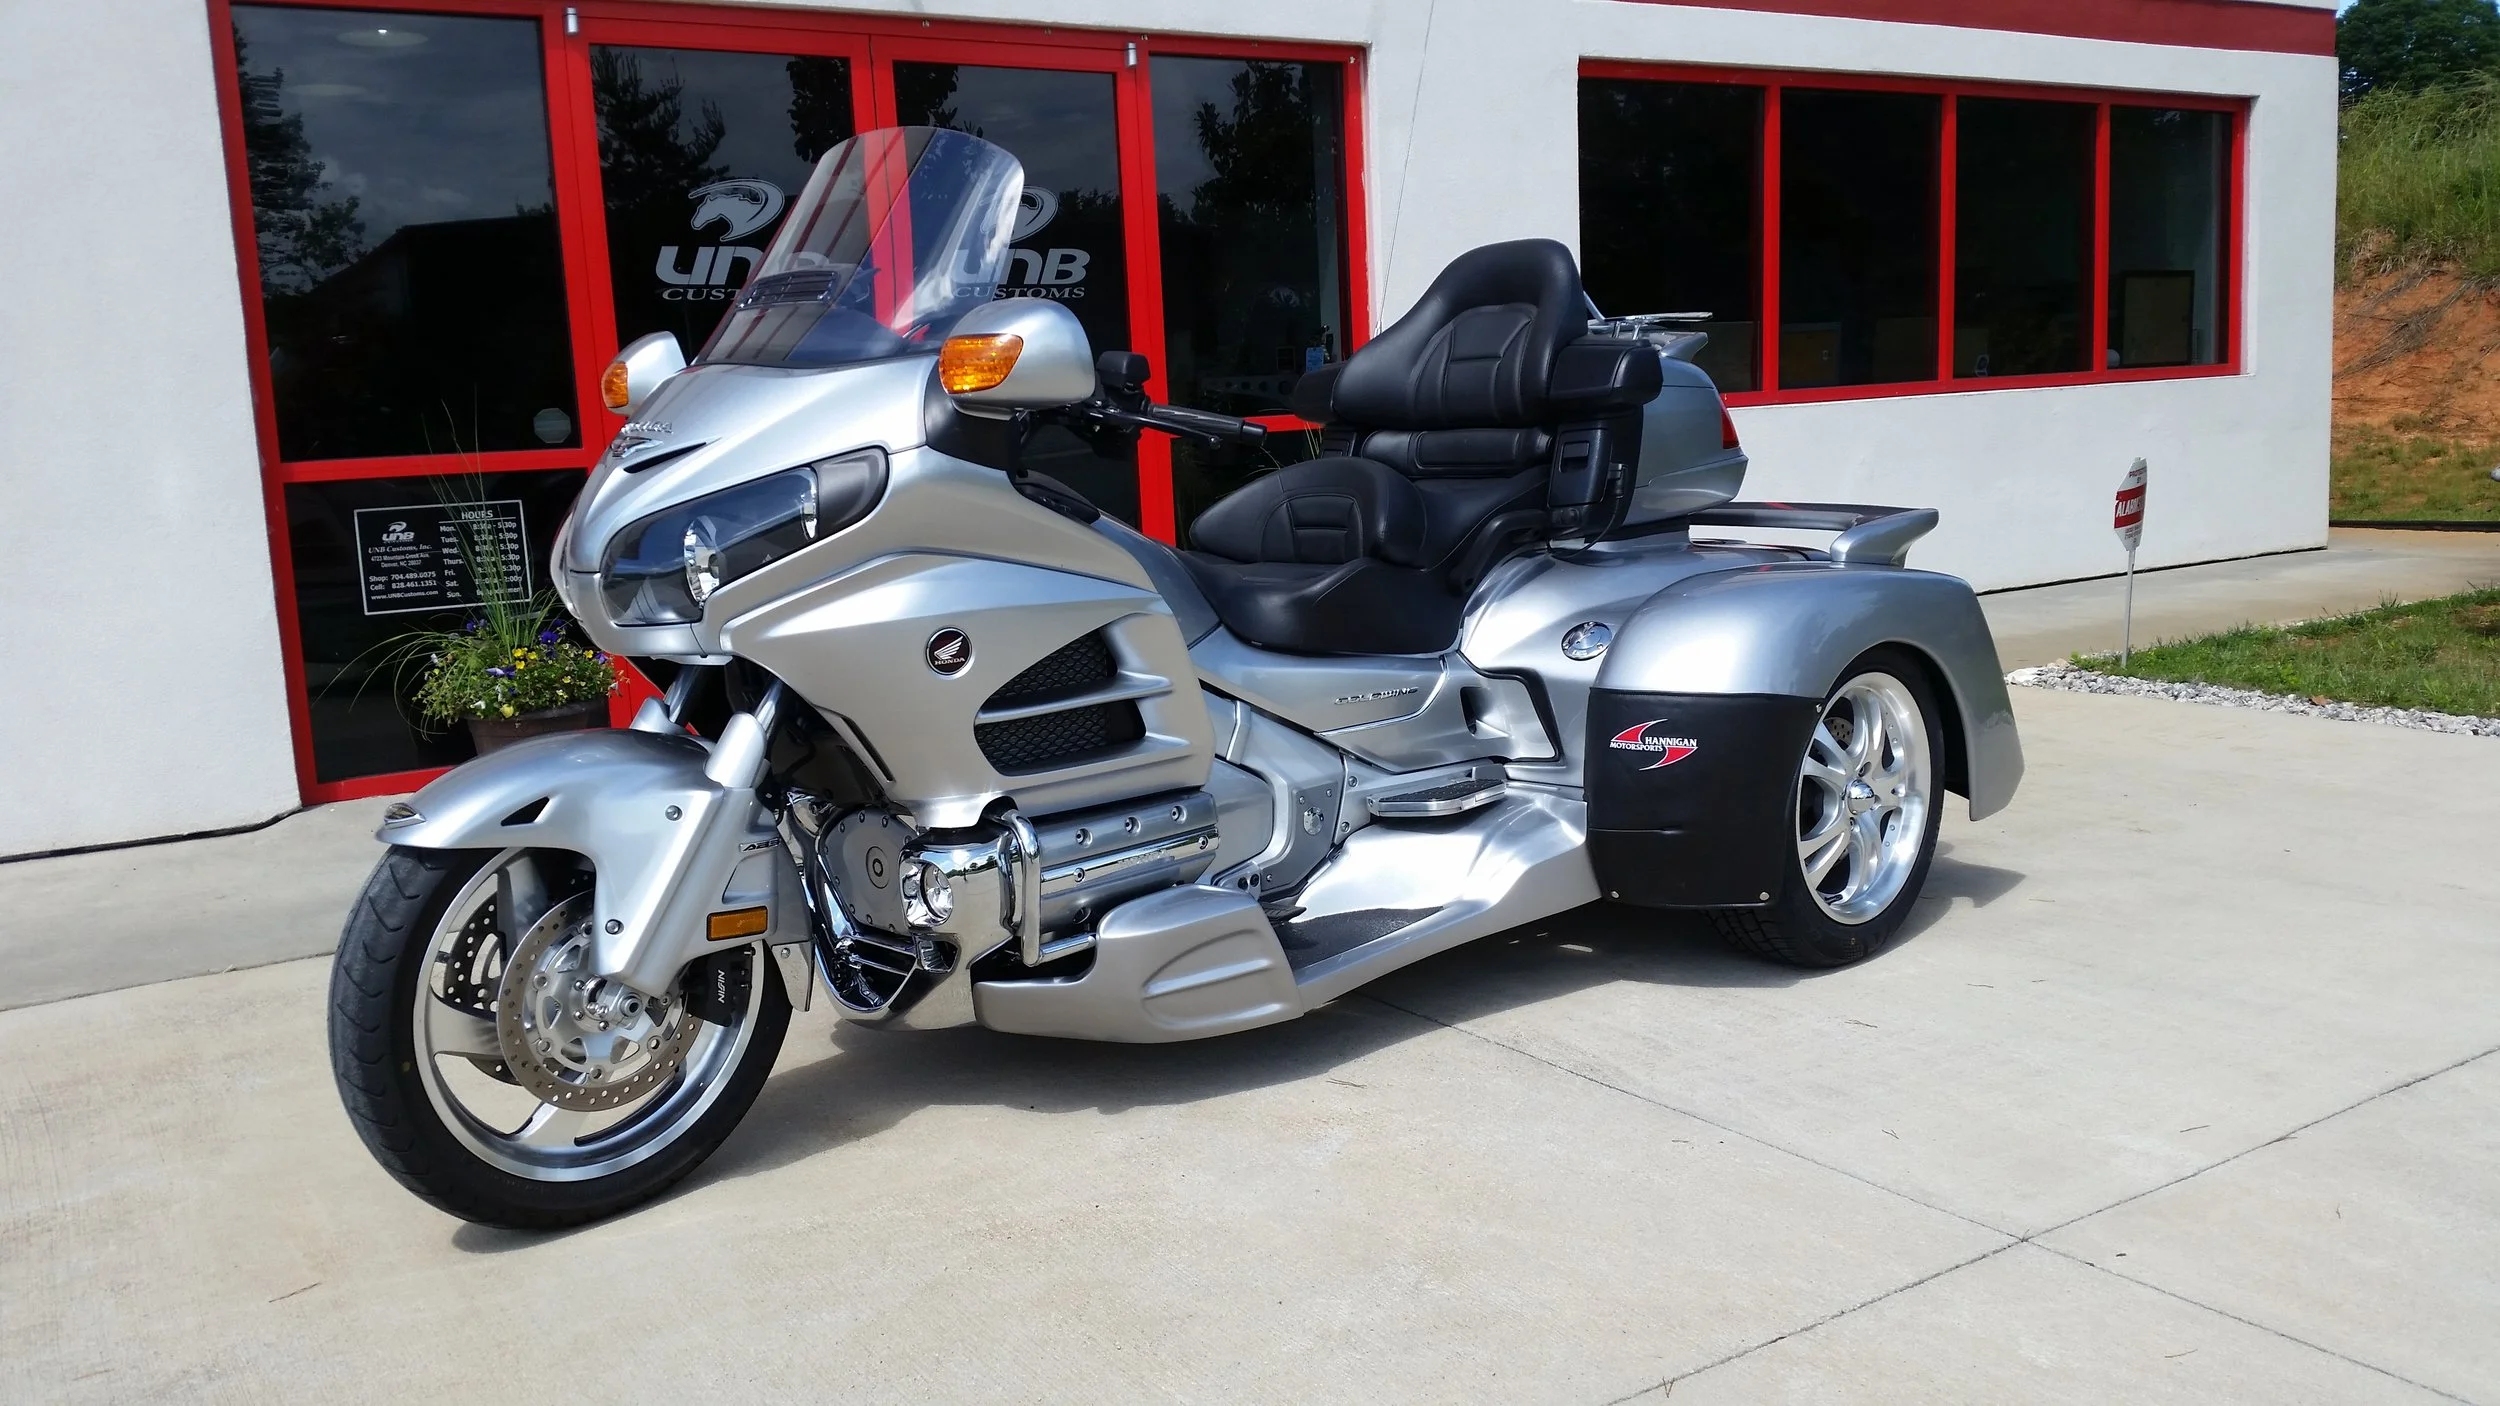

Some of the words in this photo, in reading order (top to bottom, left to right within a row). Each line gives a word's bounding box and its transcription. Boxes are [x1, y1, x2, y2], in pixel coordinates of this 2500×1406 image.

[662, 287, 742, 301] CUST
[954, 286, 1085, 299] CUSTOMS
[461, 510, 493, 520] HOURS
[368, 546, 385, 554] UNB
[934, 657, 965, 665] HONDA
[1609, 741, 1663, 752] MOTORSPORTS
[1645, 736, 1697, 747] HANNIGAN
[717, 969, 726, 1004] NISSIN
